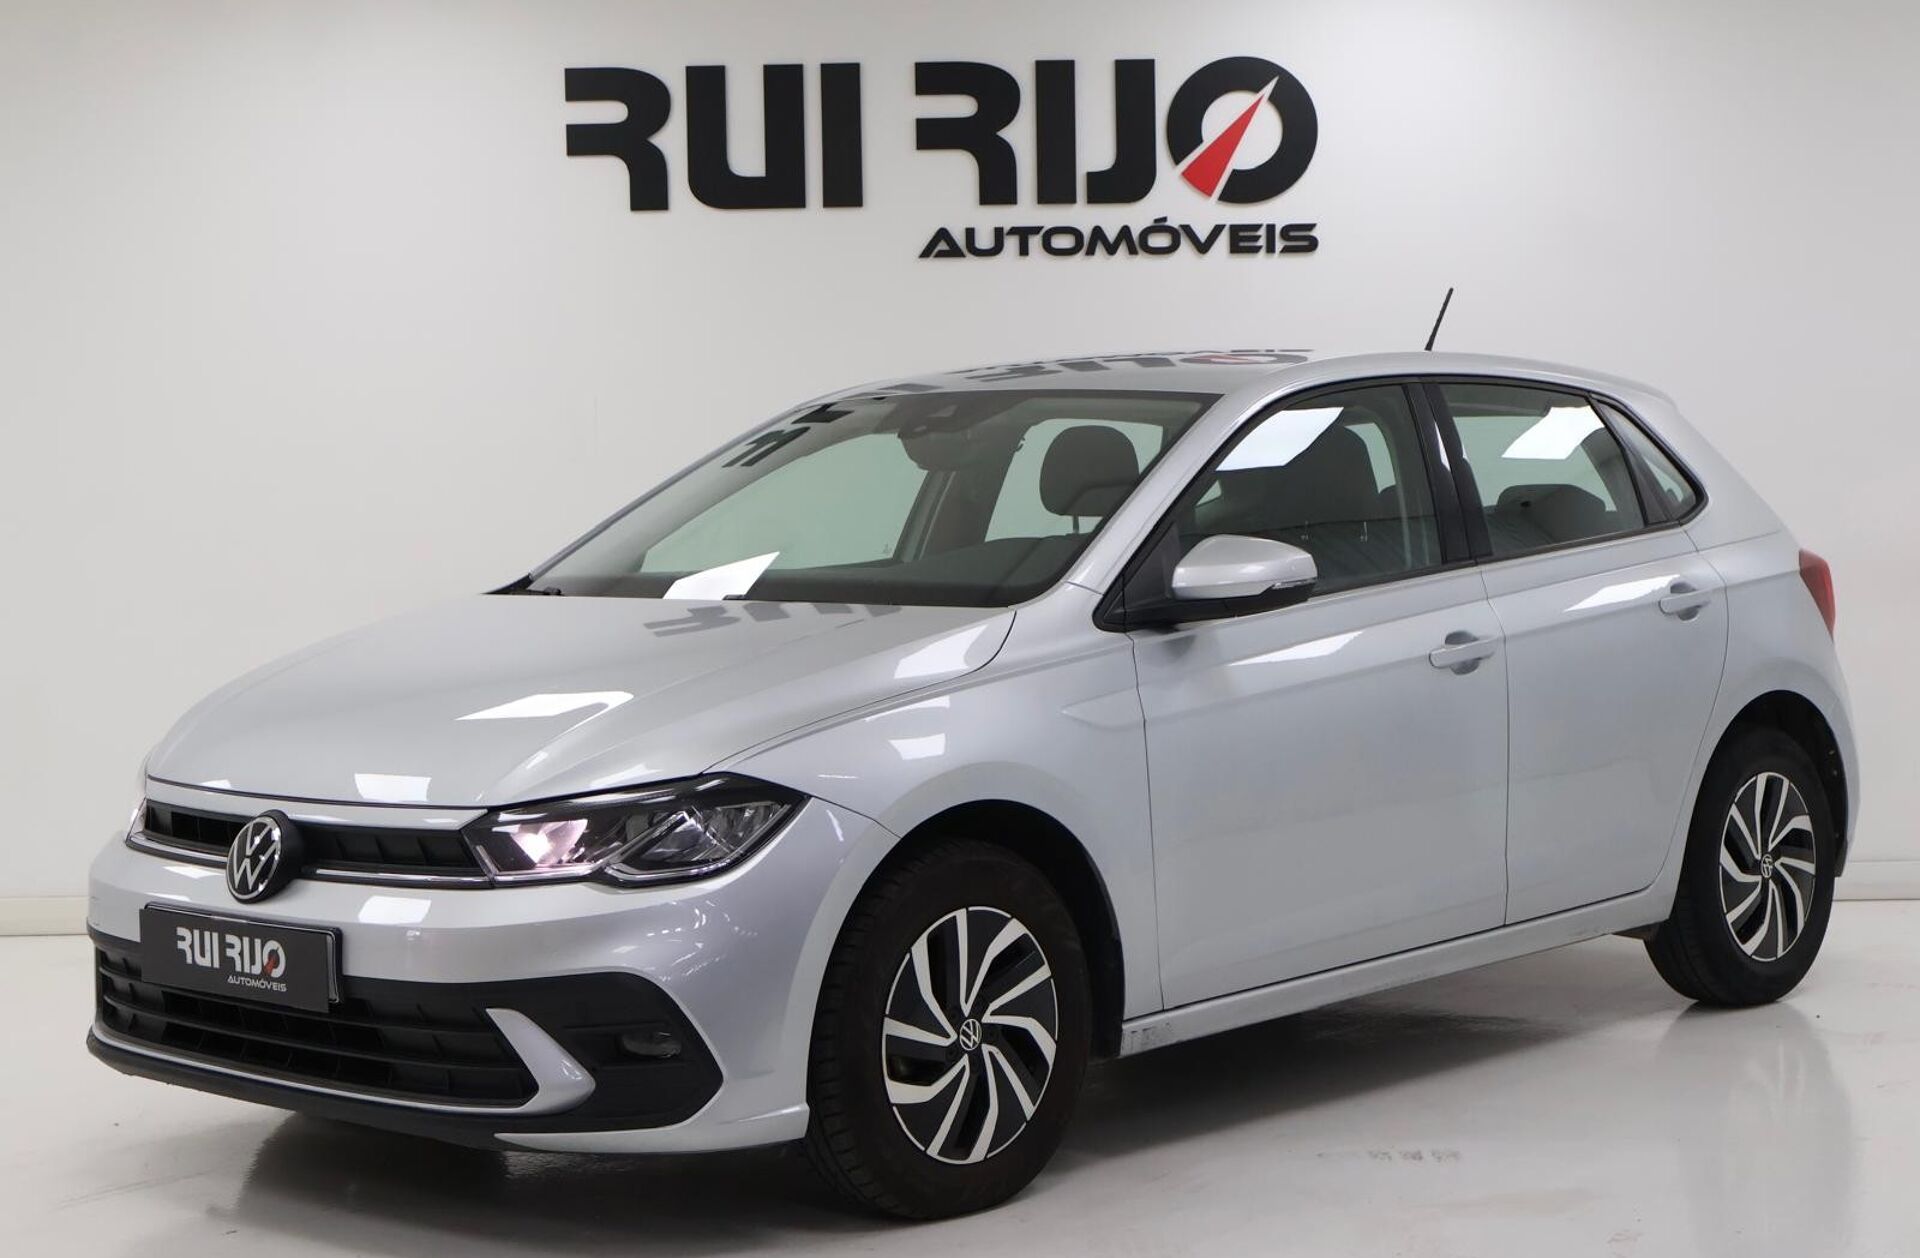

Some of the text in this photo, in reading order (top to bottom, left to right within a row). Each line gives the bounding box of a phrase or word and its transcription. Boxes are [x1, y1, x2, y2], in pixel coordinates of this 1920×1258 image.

[564, 56, 1319, 212] RUI RIJO
[918, 216, 1319, 259] AUTOMÓVEIS
[176, 926, 286, 978] RUI RIJO
[227, 975, 287, 992] AUTOMÓVEIS
